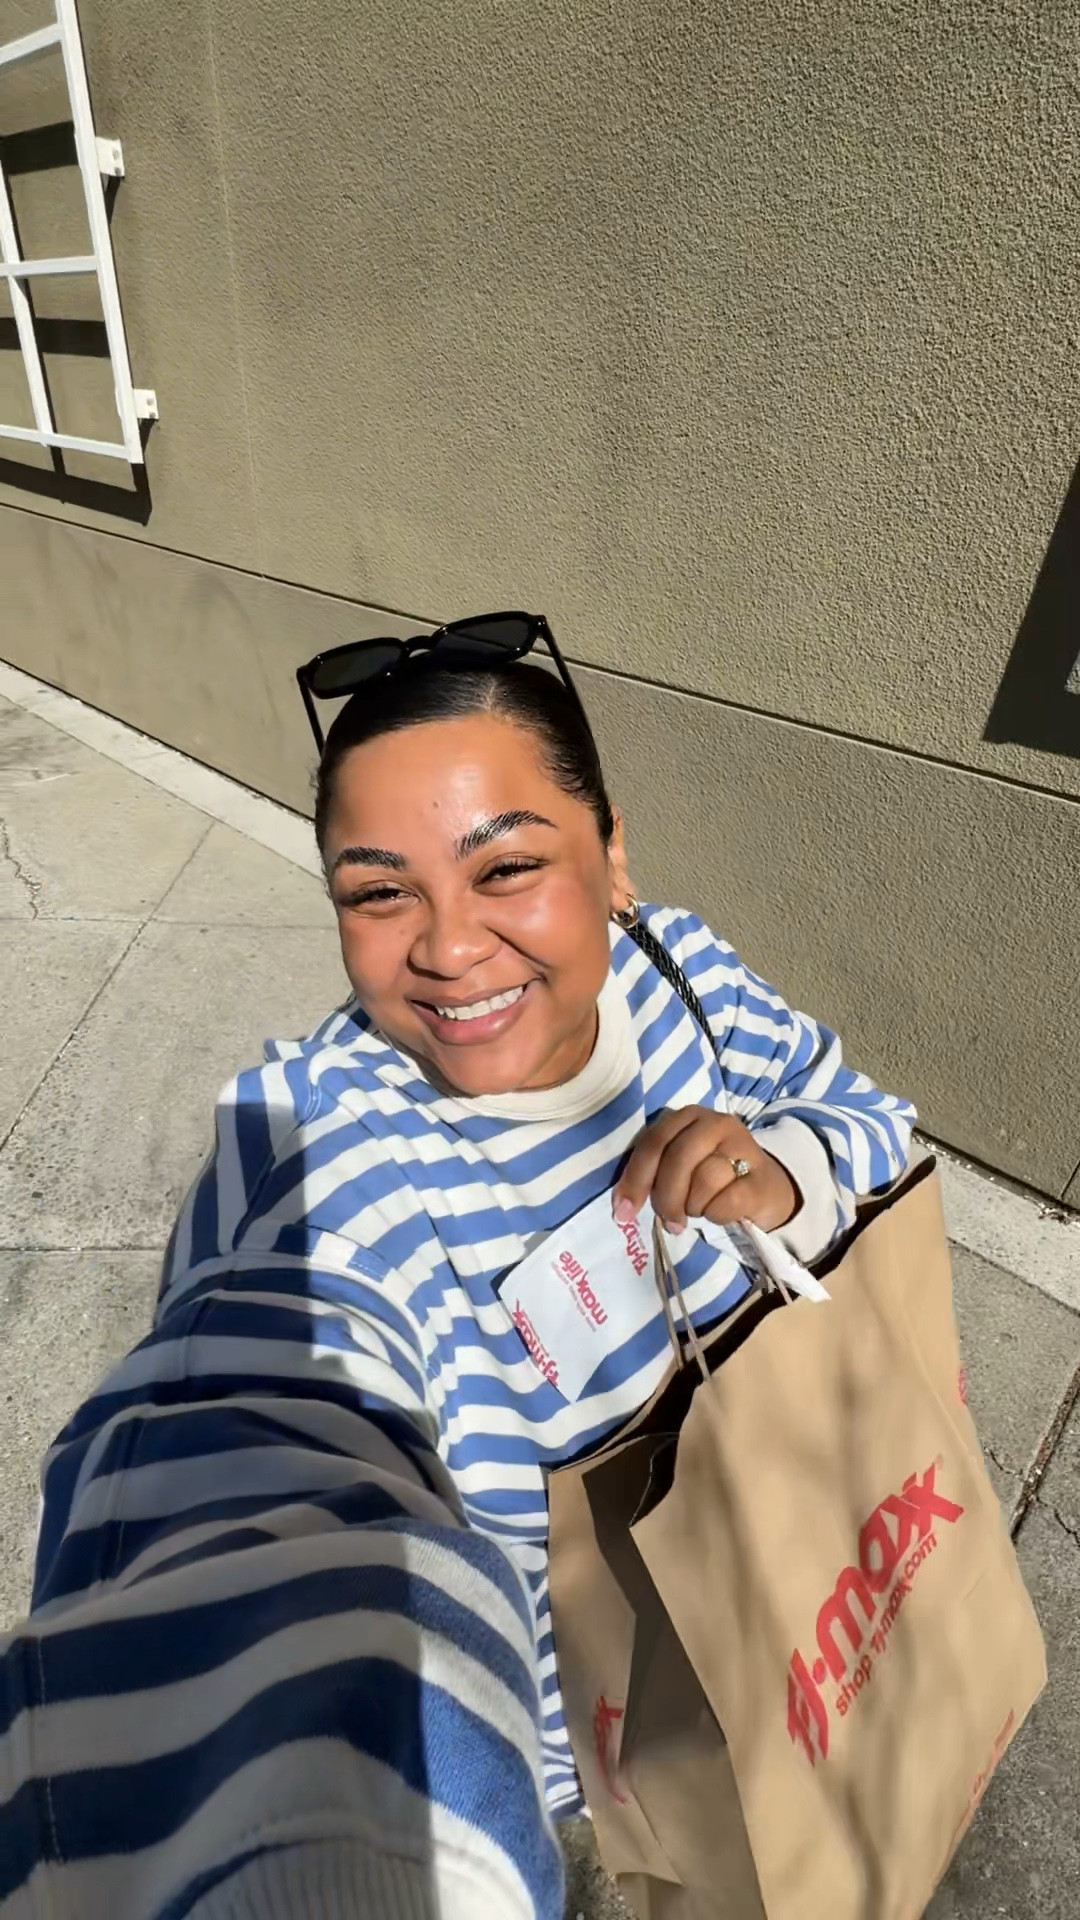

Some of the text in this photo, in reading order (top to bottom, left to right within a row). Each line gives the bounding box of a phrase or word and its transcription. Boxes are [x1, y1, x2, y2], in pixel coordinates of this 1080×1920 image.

[559, 1251, 584, 1281] life
[576, 1270, 608, 1325] maxx
[836, 1655, 872, 1717] shop
